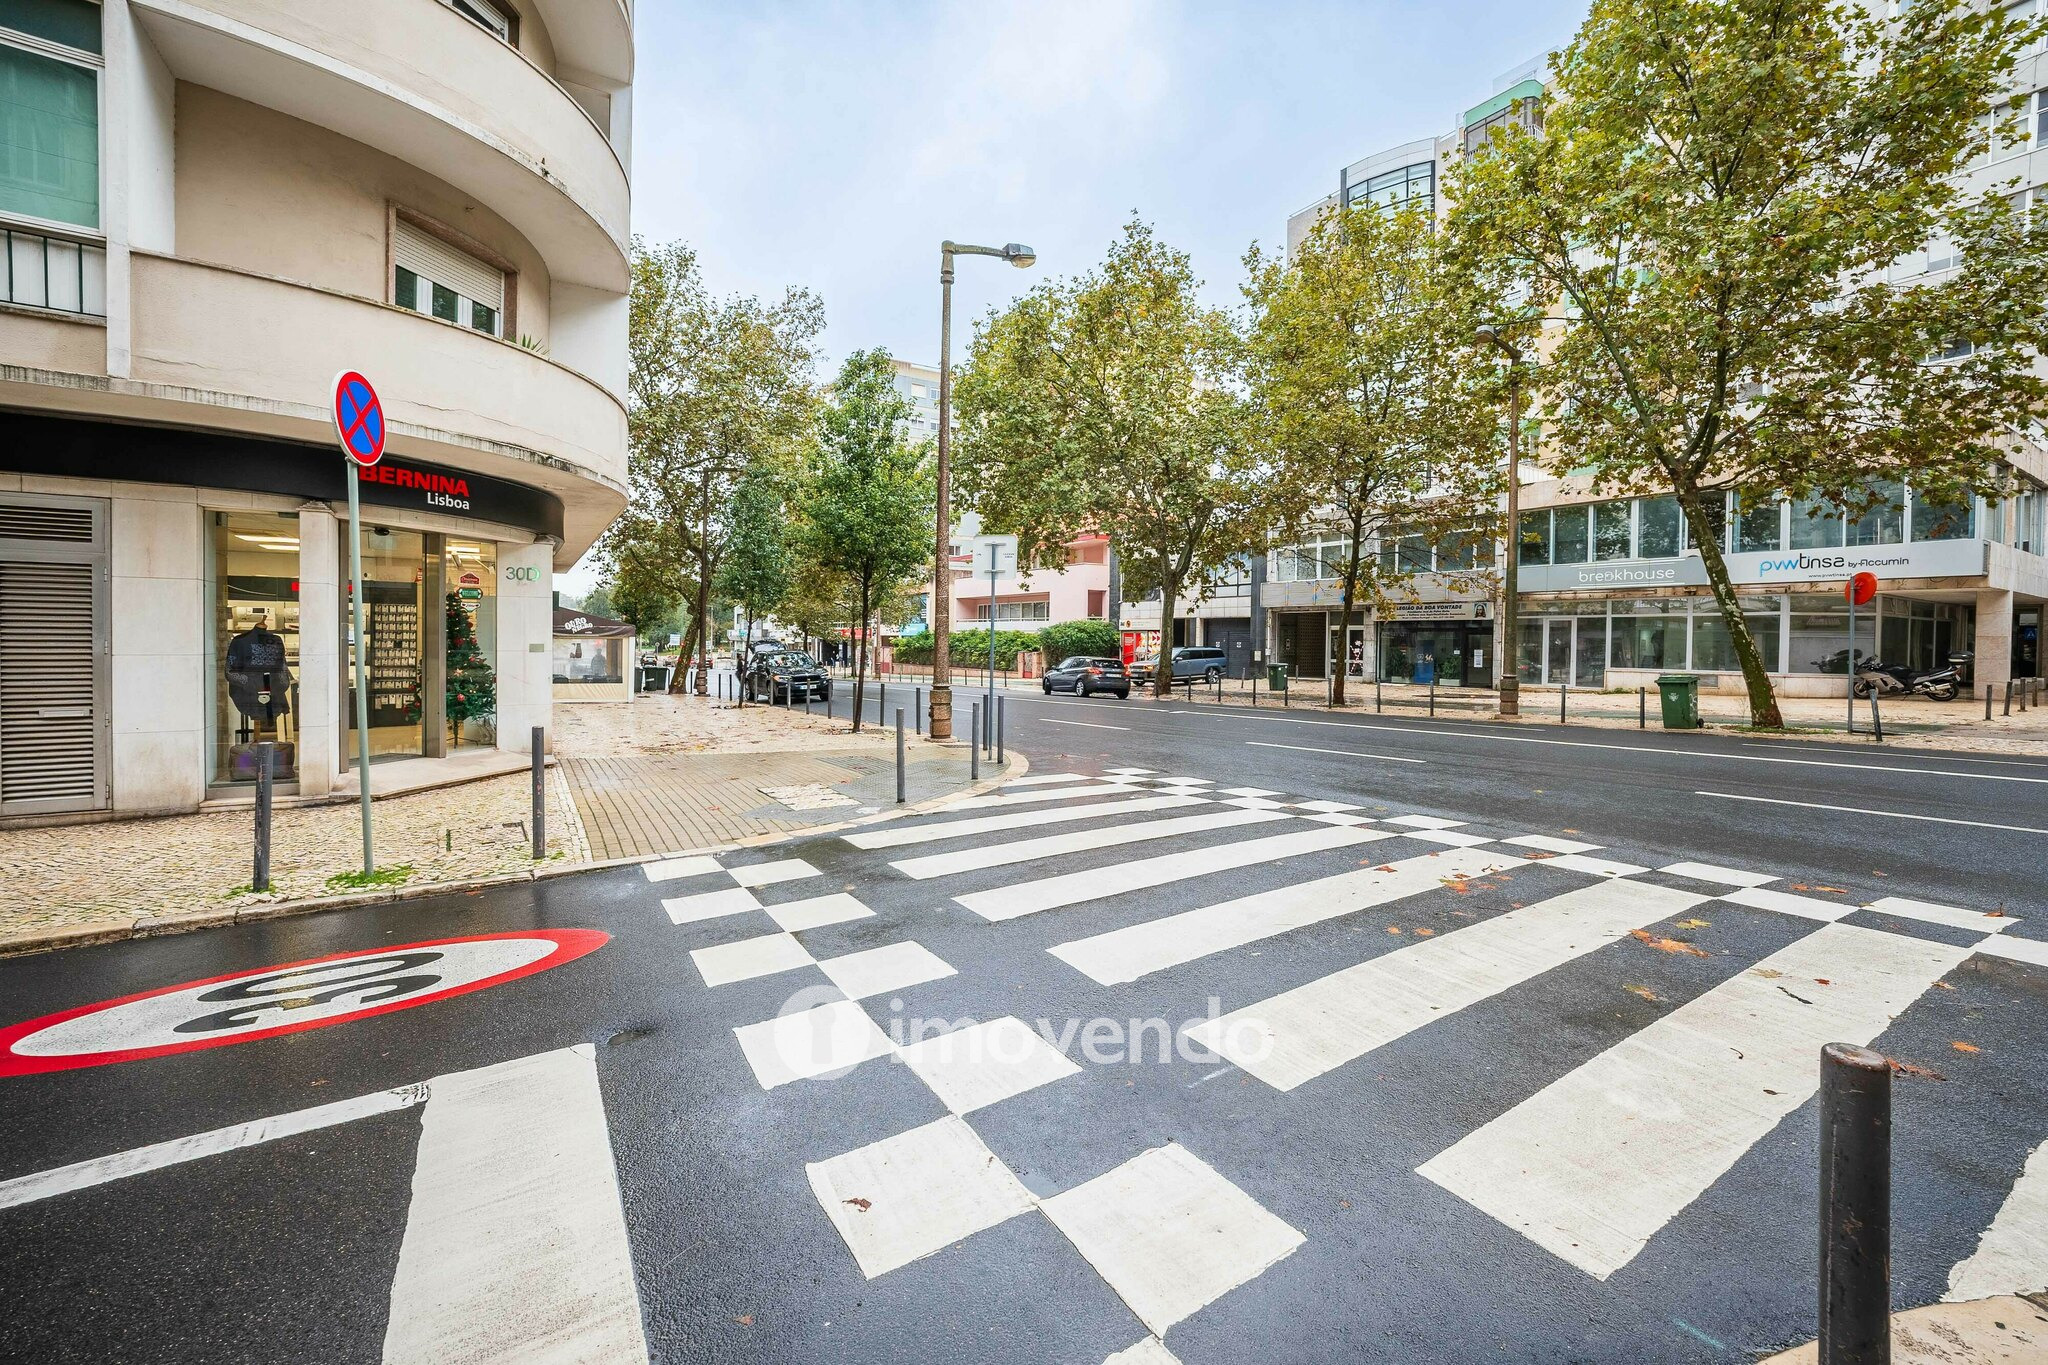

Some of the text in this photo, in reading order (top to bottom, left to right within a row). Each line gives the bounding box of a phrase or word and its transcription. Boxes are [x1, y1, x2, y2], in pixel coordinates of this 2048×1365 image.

[359, 465, 470, 497] BERNINA
[427, 492, 470, 510] Lisboa
[564, 617, 587, 630] OURO
